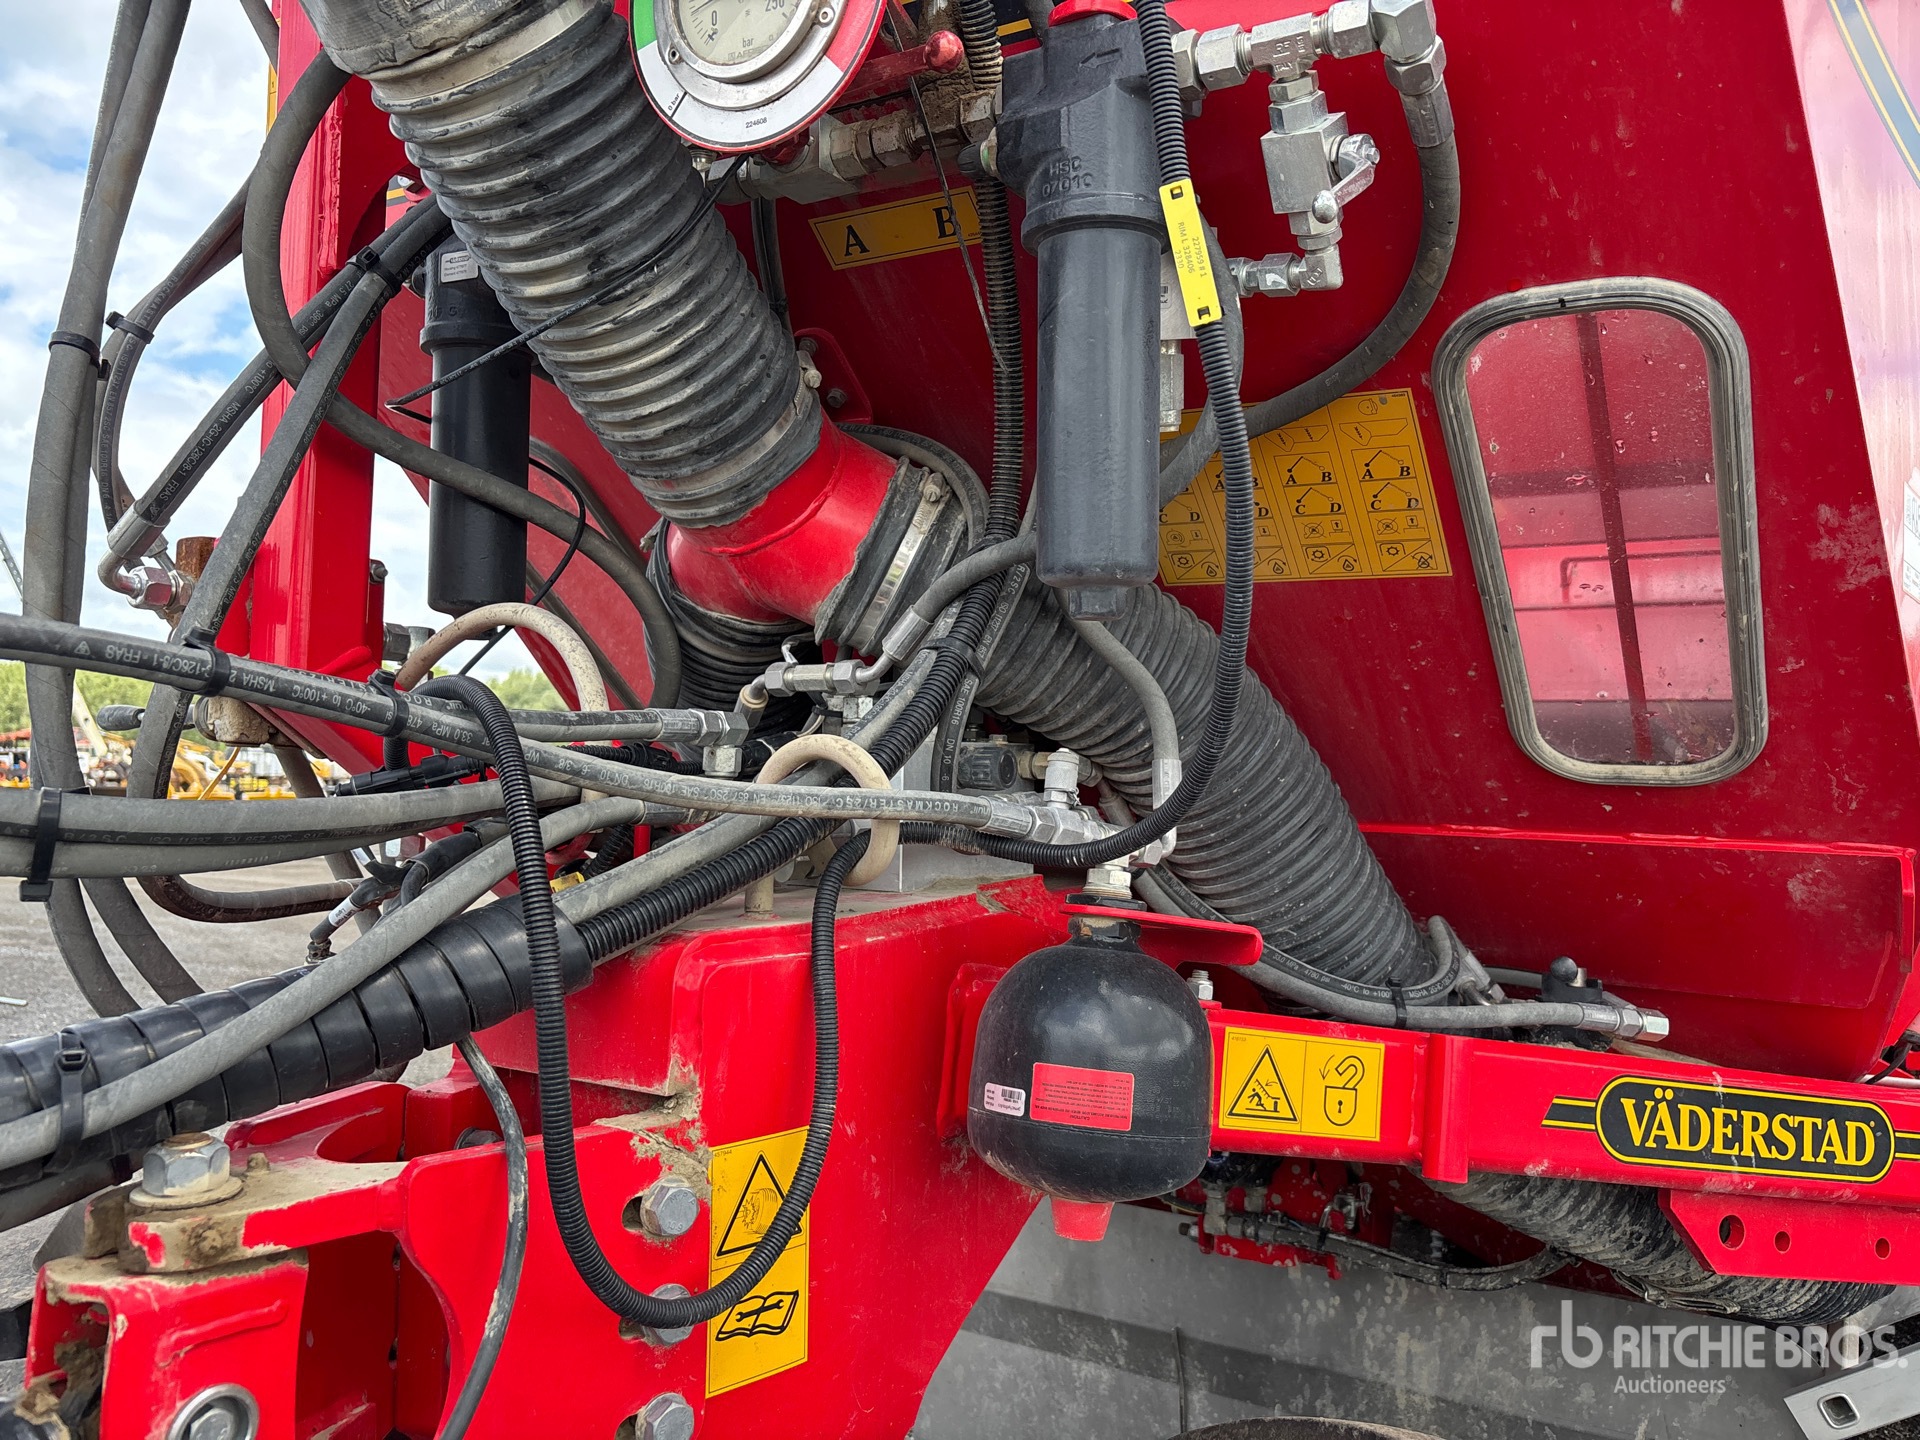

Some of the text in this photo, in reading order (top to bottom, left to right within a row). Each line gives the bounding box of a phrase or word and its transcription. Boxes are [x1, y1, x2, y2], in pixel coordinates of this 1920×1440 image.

[711, 10, 717, 26] 0
[742, 37, 754, 48] bar
[844, 205, 961, 257] A B
[219, 401, 242, 424] MSHA
[1286, 471, 1333, 485] A B
[1362, 466, 1411, 479] A B
[160, 479, 180, 501] FRAS
[1258, 507, 1269, 517] D
[1295, 502, 1342, 515] C D
[1371, 498, 1419, 510] C D
[1190, 511, 1200, 521] D
[242, 672, 276, 693] MSHA
[960, 678, 973, 695] SAE
[291, 685, 328, 701] +100°C
[332, 694, 341, 707] to
[951, 697, 966, 726] 100R16
[406, 714, 423, 729] 478
[431, 721, 450, 737] MPa
[453, 728, 473, 744] 33.0
[946, 738, 955, 752] DN
[943, 755, 952, 764] 10
[1285, 960, 1299, 971] MPa
[1304, 968, 1319, 980] 4780
[1340, 983, 1360, 994] -40°C
[1408, 988, 1428, 998] MSHA
[1620, 1087, 1875, 1167] VÄDERSTAD
